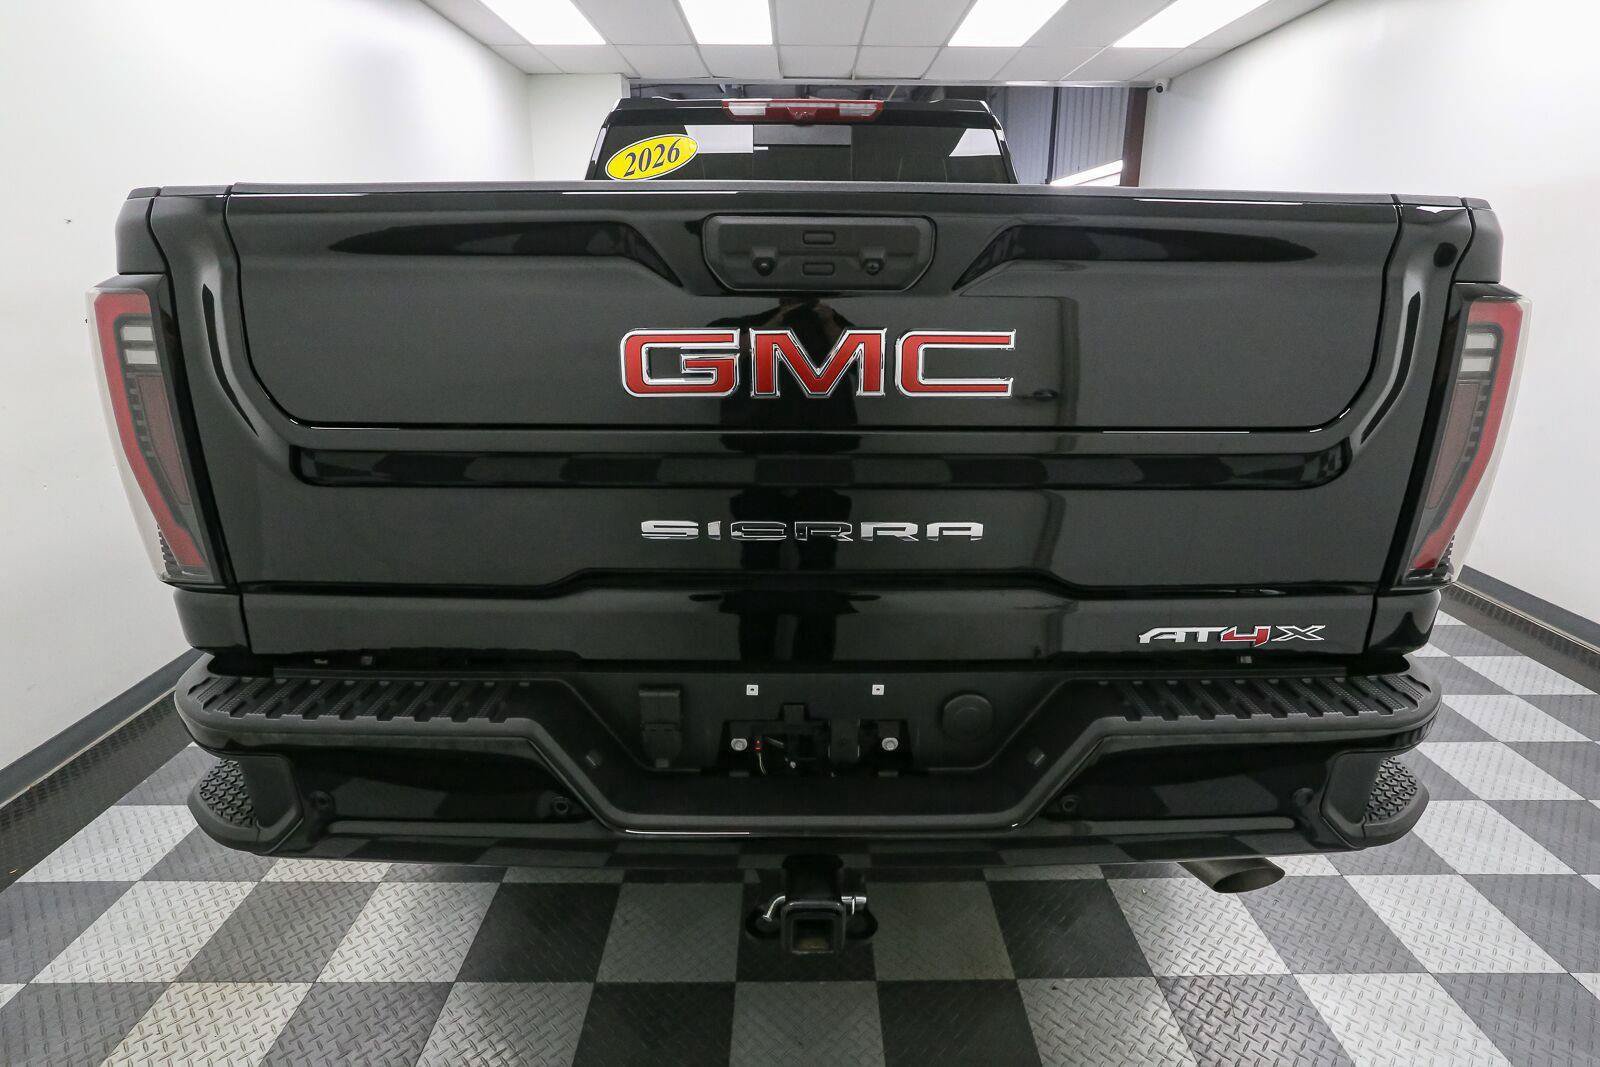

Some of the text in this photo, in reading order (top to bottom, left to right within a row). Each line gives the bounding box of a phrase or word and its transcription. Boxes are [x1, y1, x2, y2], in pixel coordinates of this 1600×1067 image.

[622, 139, 681, 178] 2026
[619, 327, 1016, 398] GMC
[641, 520, 984, 542] SIERRA
[1138, 625, 1326, 647] AT4X
